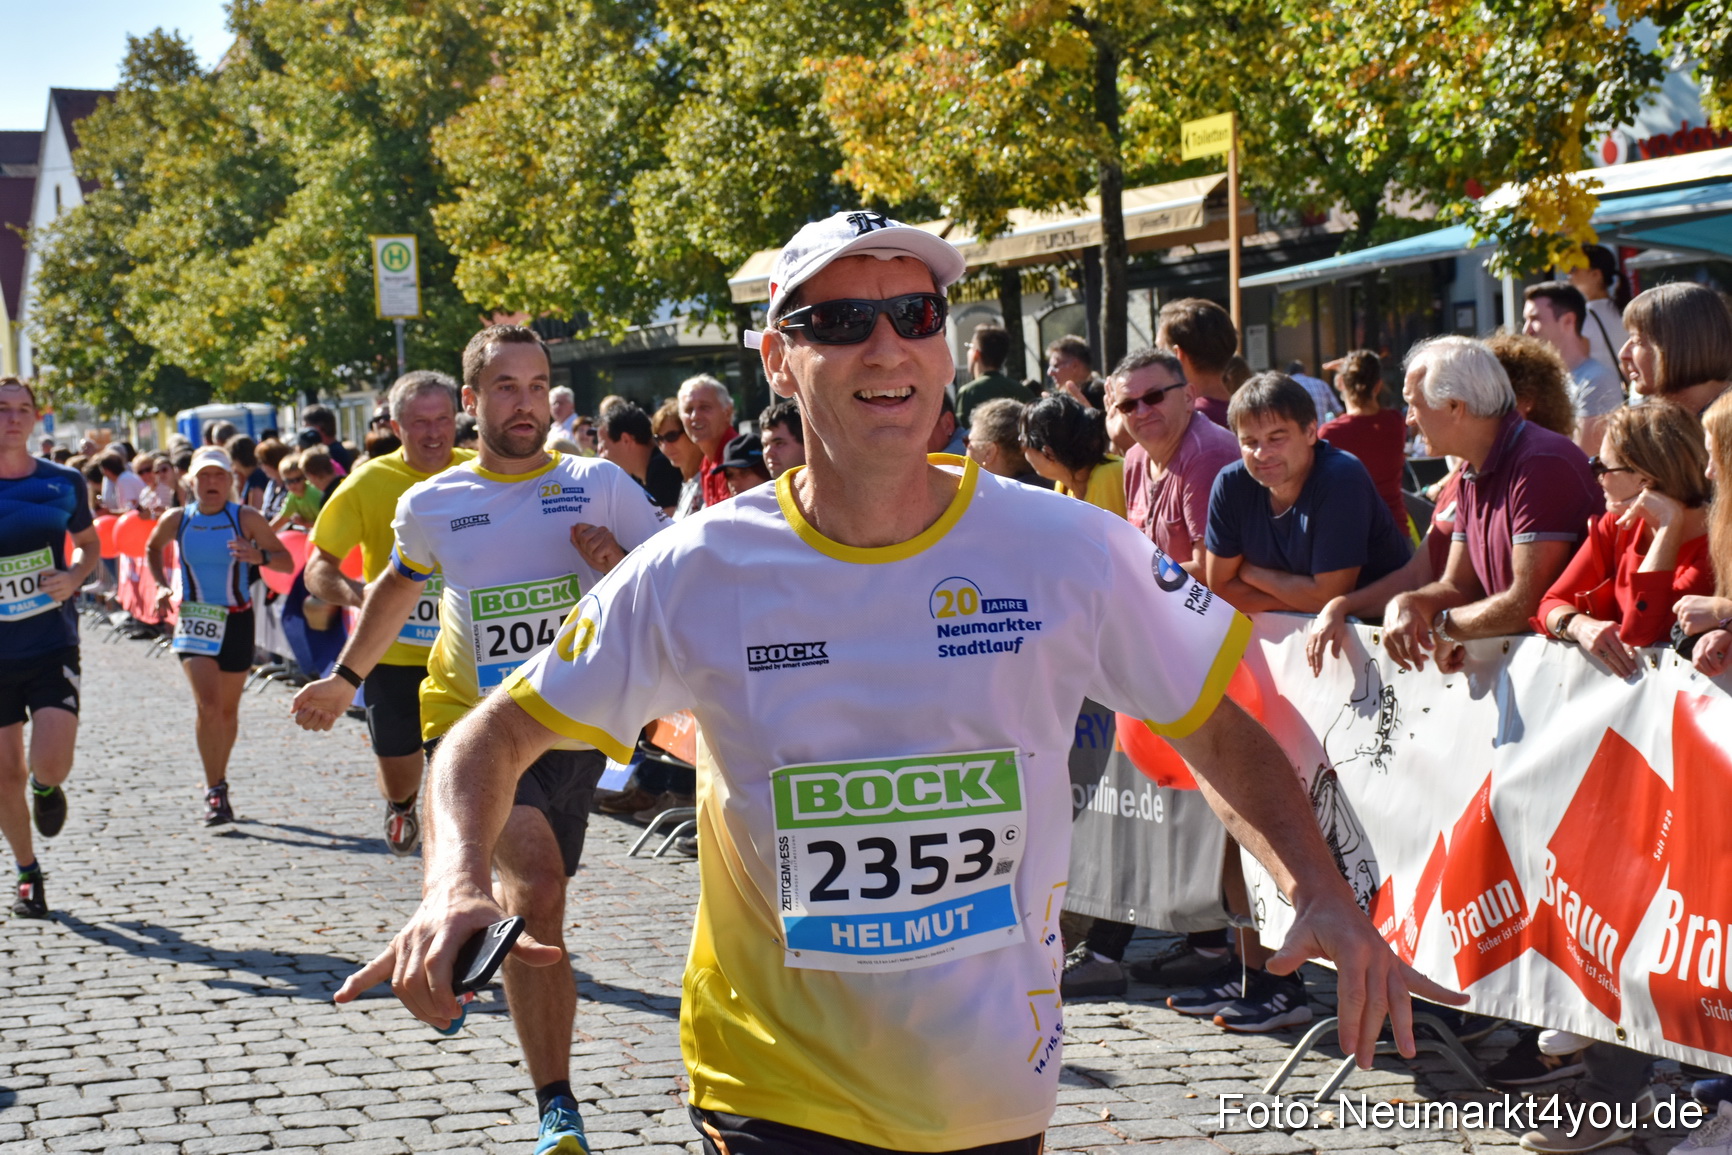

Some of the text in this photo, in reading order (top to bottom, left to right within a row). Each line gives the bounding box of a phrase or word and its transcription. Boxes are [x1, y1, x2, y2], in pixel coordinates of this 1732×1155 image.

[541, 484, 561, 498] 20
[541, 496, 591, 506] Neumarkter
[451, 514, 490, 529] BOCK
[543, 505, 582, 514] Stadtlauf
[0, 552, 47, 574] OCK
[480, 581, 574, 615] BOCK
[935, 587, 1025, 619] 20 JAHRE
[1184, 579, 1204, 611] PAR
[179, 620, 217, 638] 2268
[486, 614, 569, 657] 204
[937, 618, 1042, 638] Neumarkter
[747, 641, 828, 665] BOCK
[938, 636, 1024, 658] Stadtlauf
[748, 664, 773, 672] inspired
[801, 659, 830, 667] concepts
[791, 762, 1001, 819] BOCK
[1653, 809, 1673, 862] Seit 1929
[807, 828, 996, 902] 2353
[831, 903, 974, 948] HELMUT
[1442, 880, 1520, 956] Braun
[1544, 848, 1619, 975] Braun
[1477, 935, 1502, 954] Sicher
[1501, 927, 1512, 940] ist
[1566, 936, 1584, 968] Sicher
[1585, 961, 1597, 979] ist
